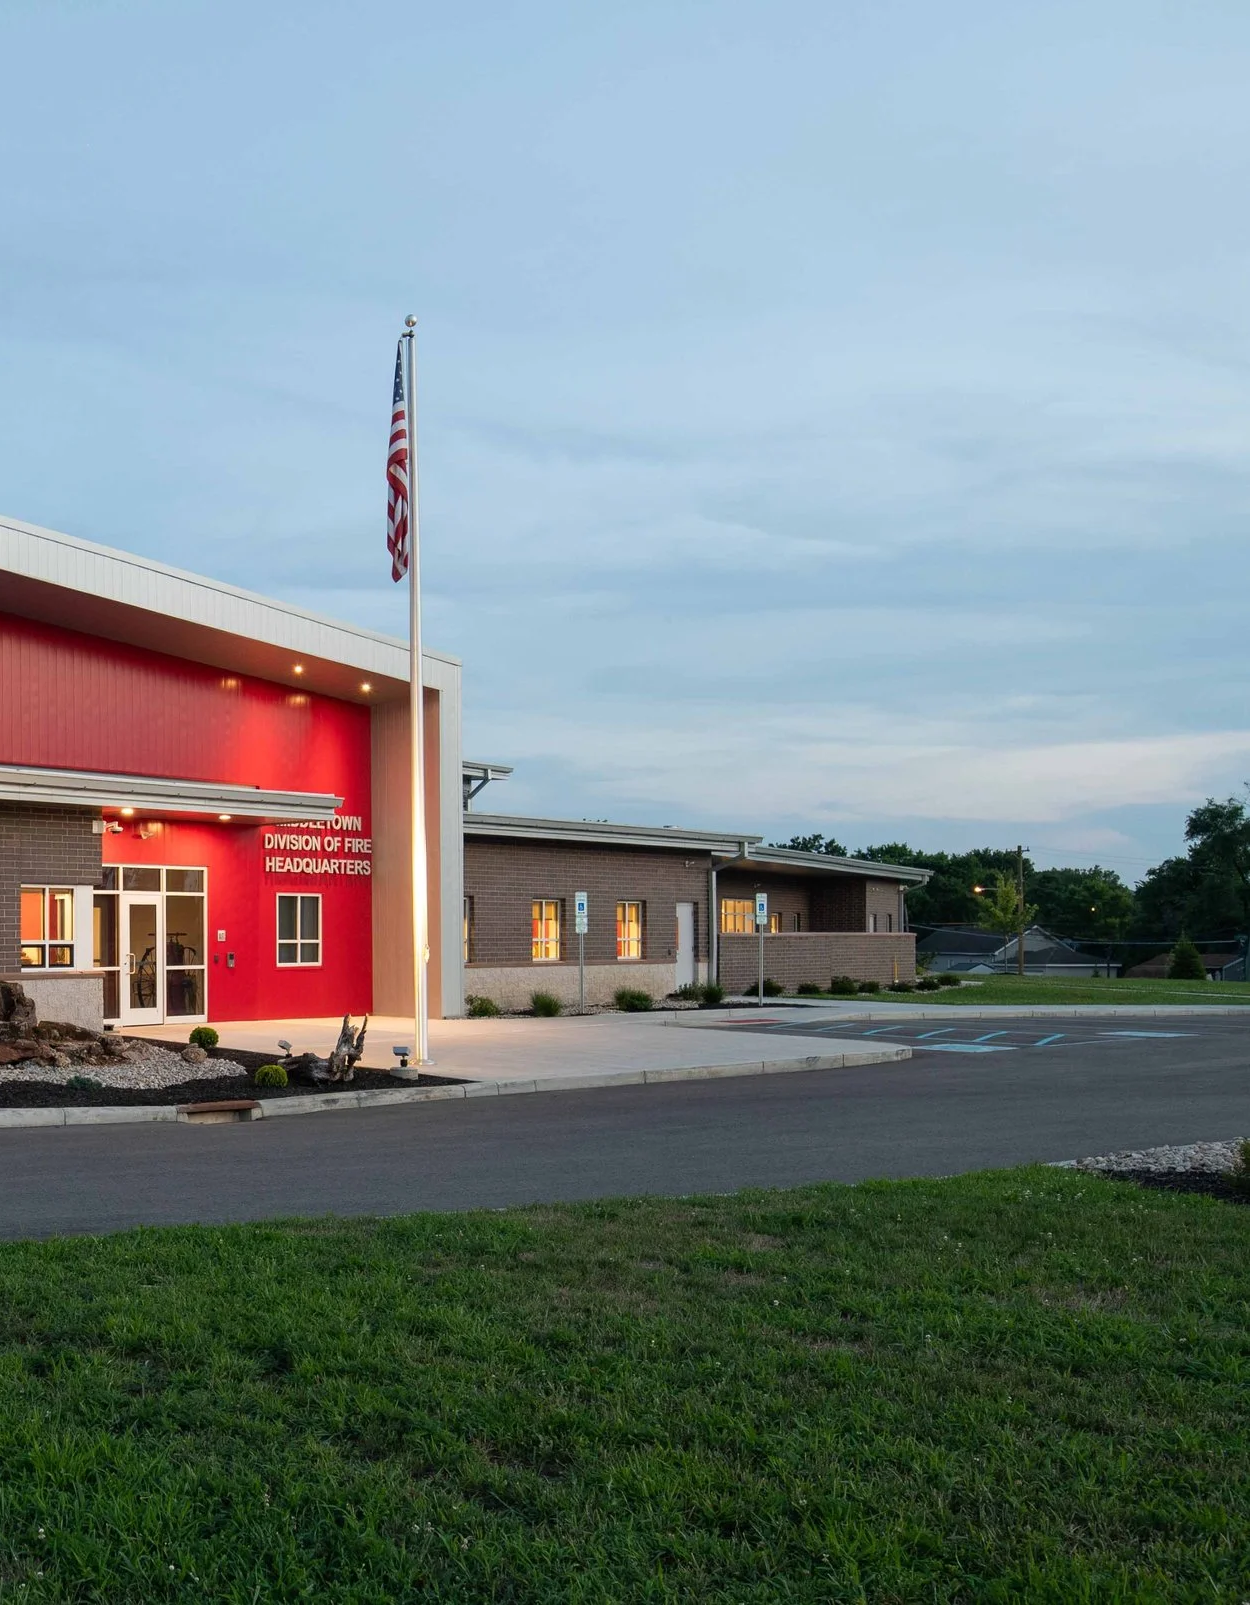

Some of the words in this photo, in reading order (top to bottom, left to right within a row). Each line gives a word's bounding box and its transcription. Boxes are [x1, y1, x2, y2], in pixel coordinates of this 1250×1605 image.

[276, 815, 362, 831] LETOWN
[264, 833, 321, 851] DIVISION
[323, 836, 342, 852] OF
[344, 838, 372, 853] FIRE
[265, 857, 371, 875] HEADQUARTERS
